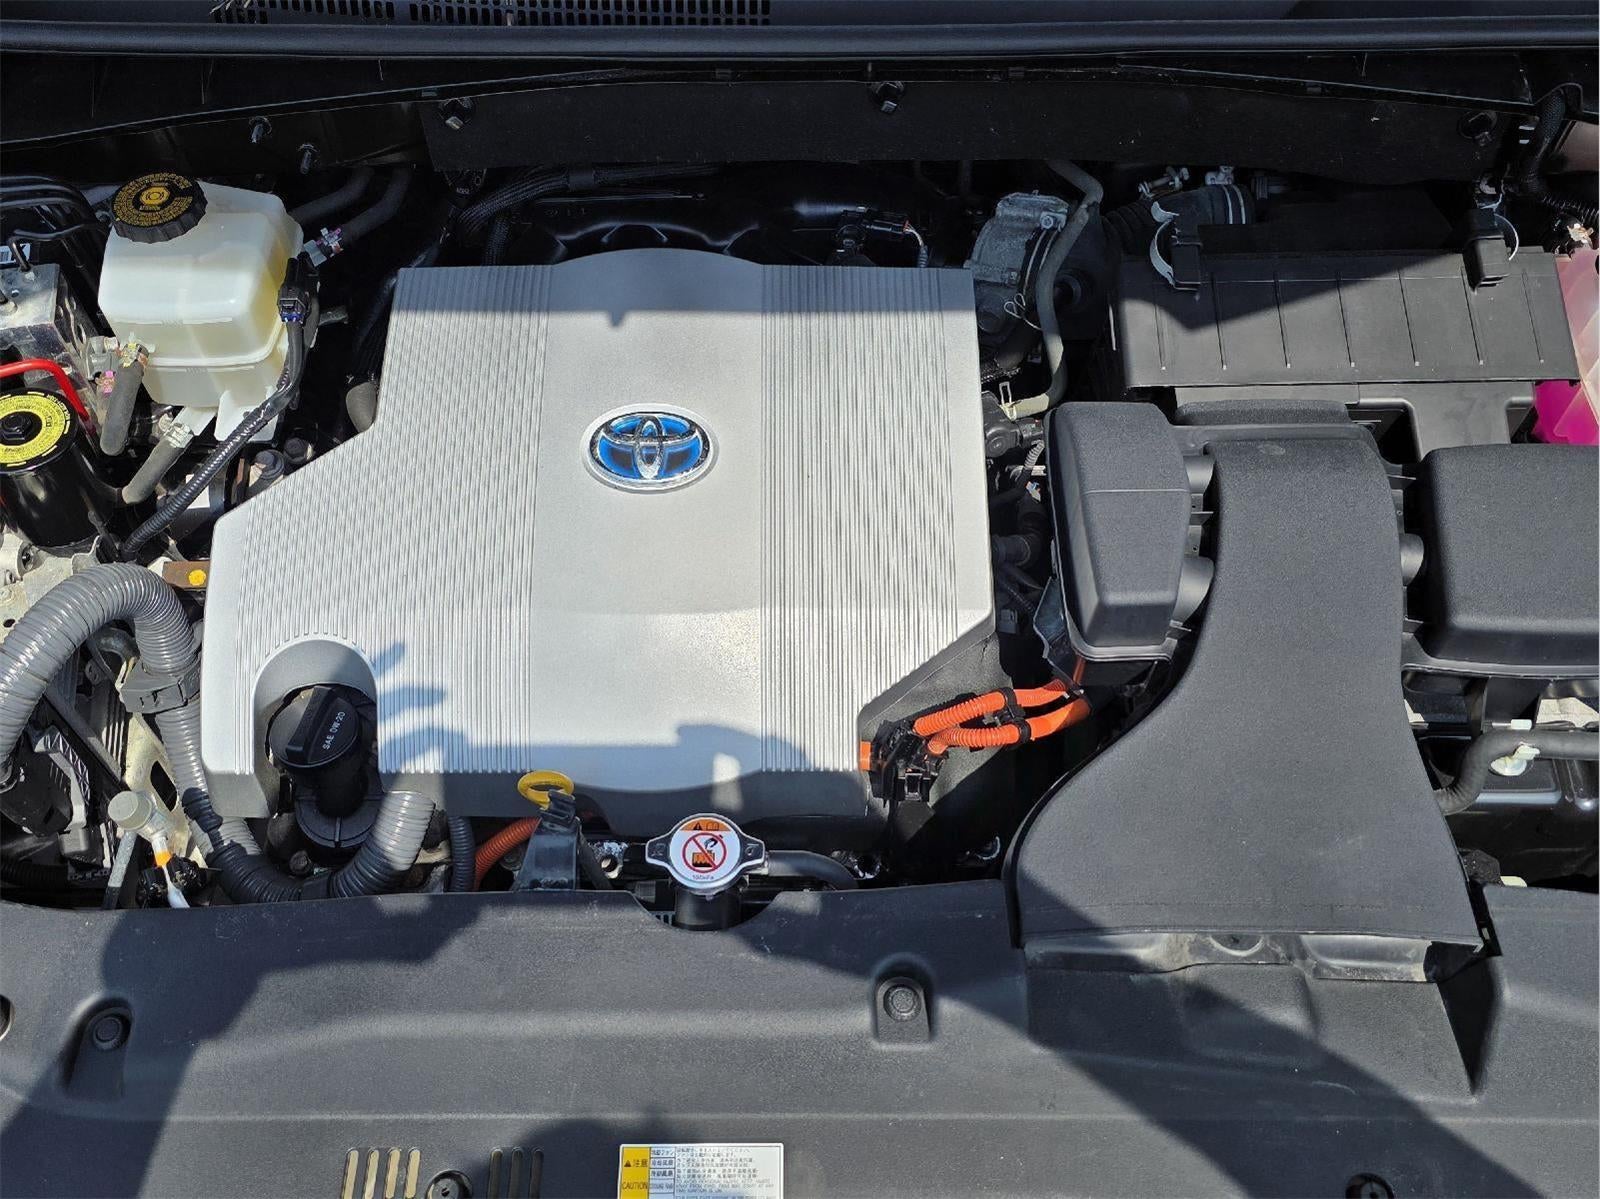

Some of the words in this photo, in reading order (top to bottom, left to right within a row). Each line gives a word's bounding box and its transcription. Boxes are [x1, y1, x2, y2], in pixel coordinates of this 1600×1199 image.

[322, 735, 335, 750] SAE
[632, 1158, 649, 1168] 注意
[622, 1181, 648, 1190] CAUTION
